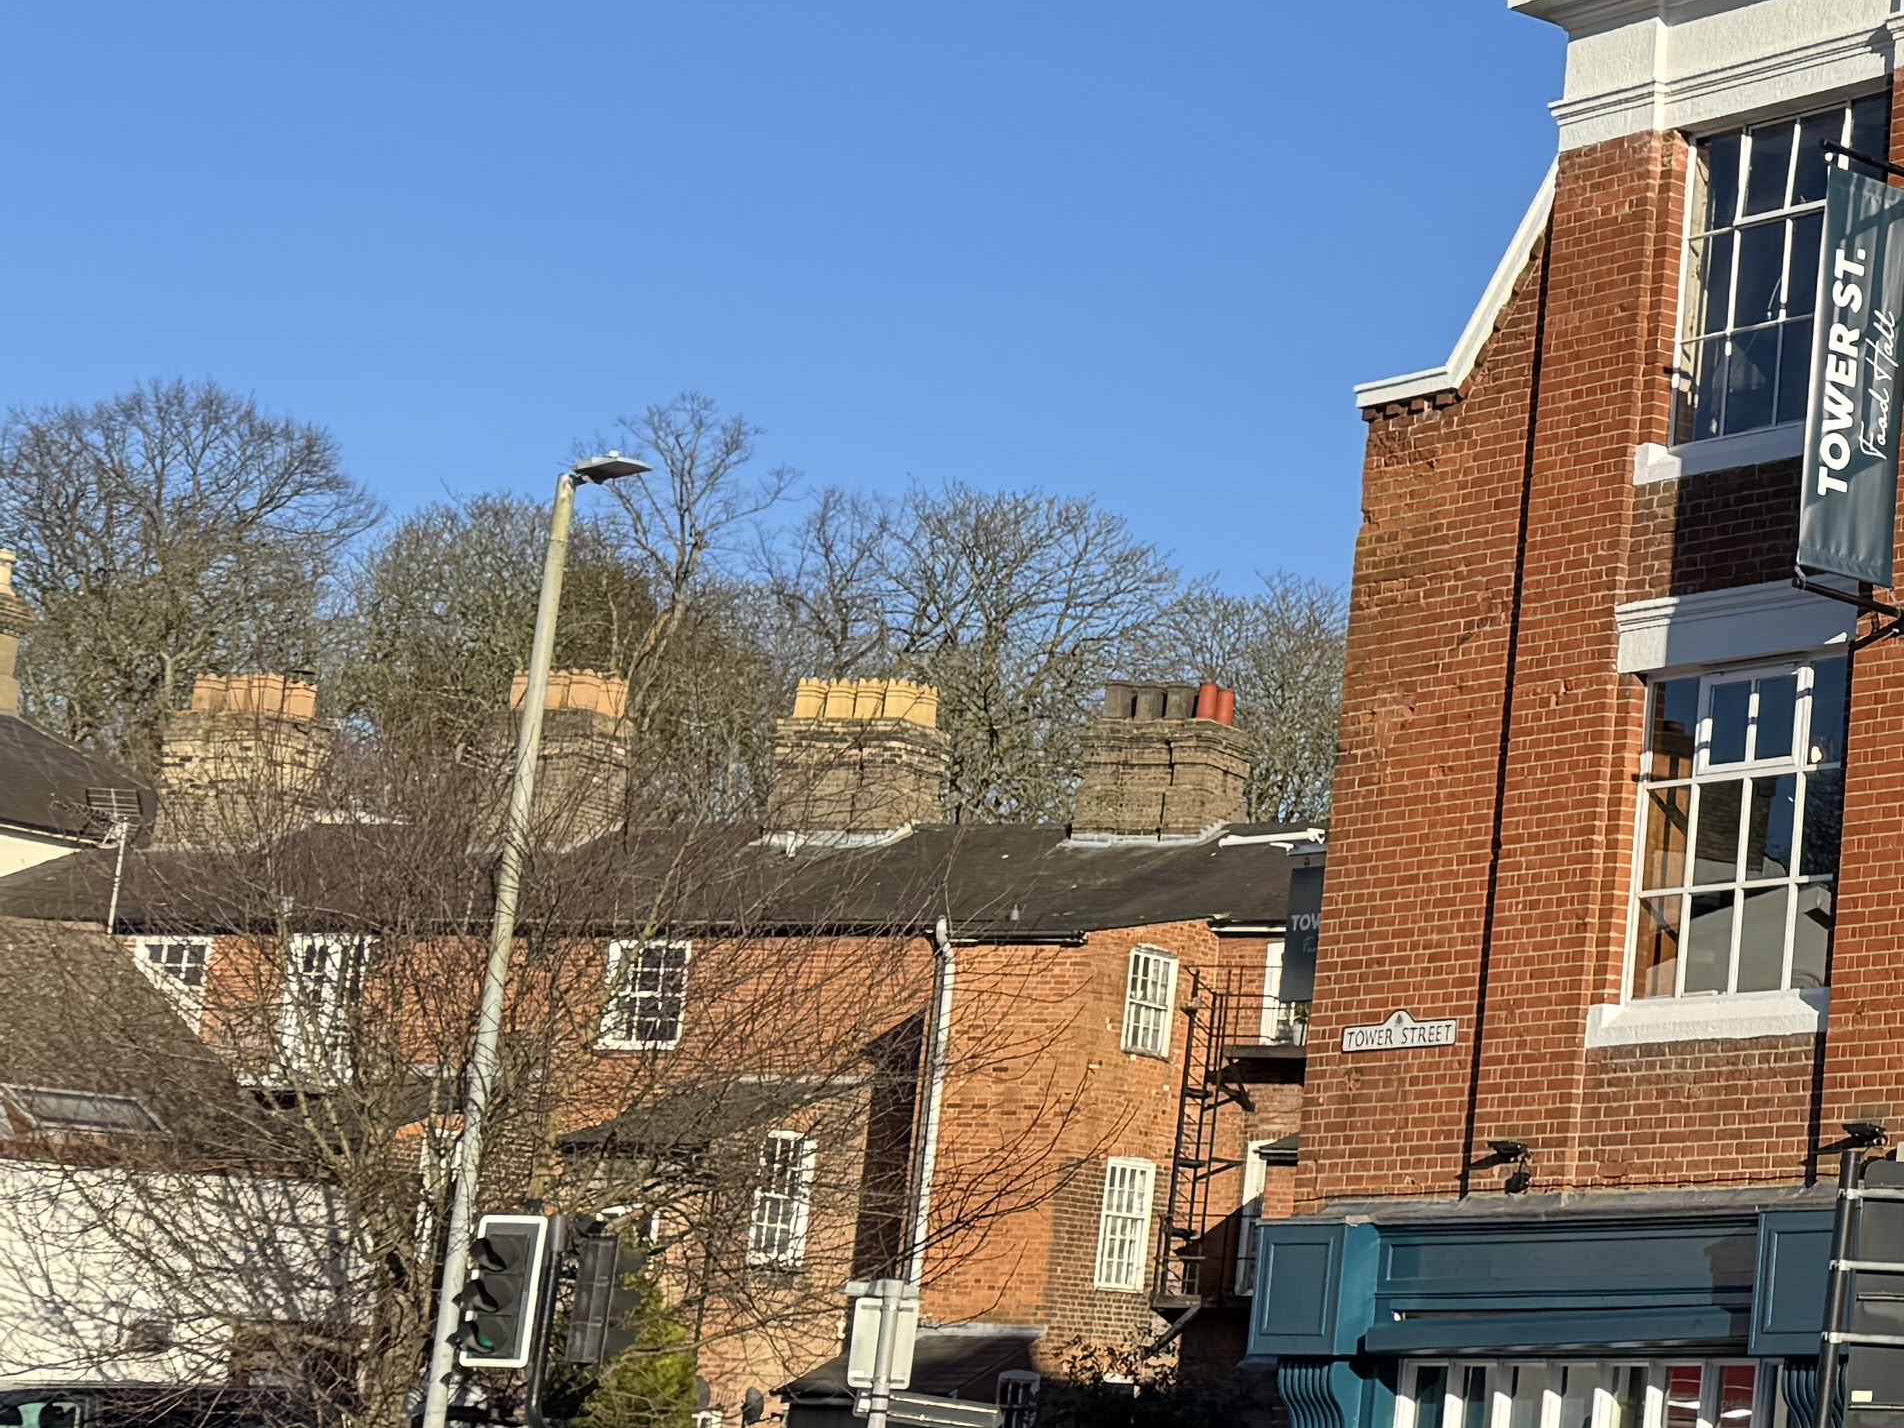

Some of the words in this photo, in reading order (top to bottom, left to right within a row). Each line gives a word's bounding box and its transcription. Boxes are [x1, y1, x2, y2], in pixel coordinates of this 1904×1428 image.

[1832, 248, 1866, 314] ST.
[1865, 309, 1899, 381] Hall
[1817, 323, 1861, 496] TOWER
[1858, 387, 1891, 460] Food
[1347, 1028, 1393, 1048] TOWER
[1401, 1024, 1452, 1044] STREET
